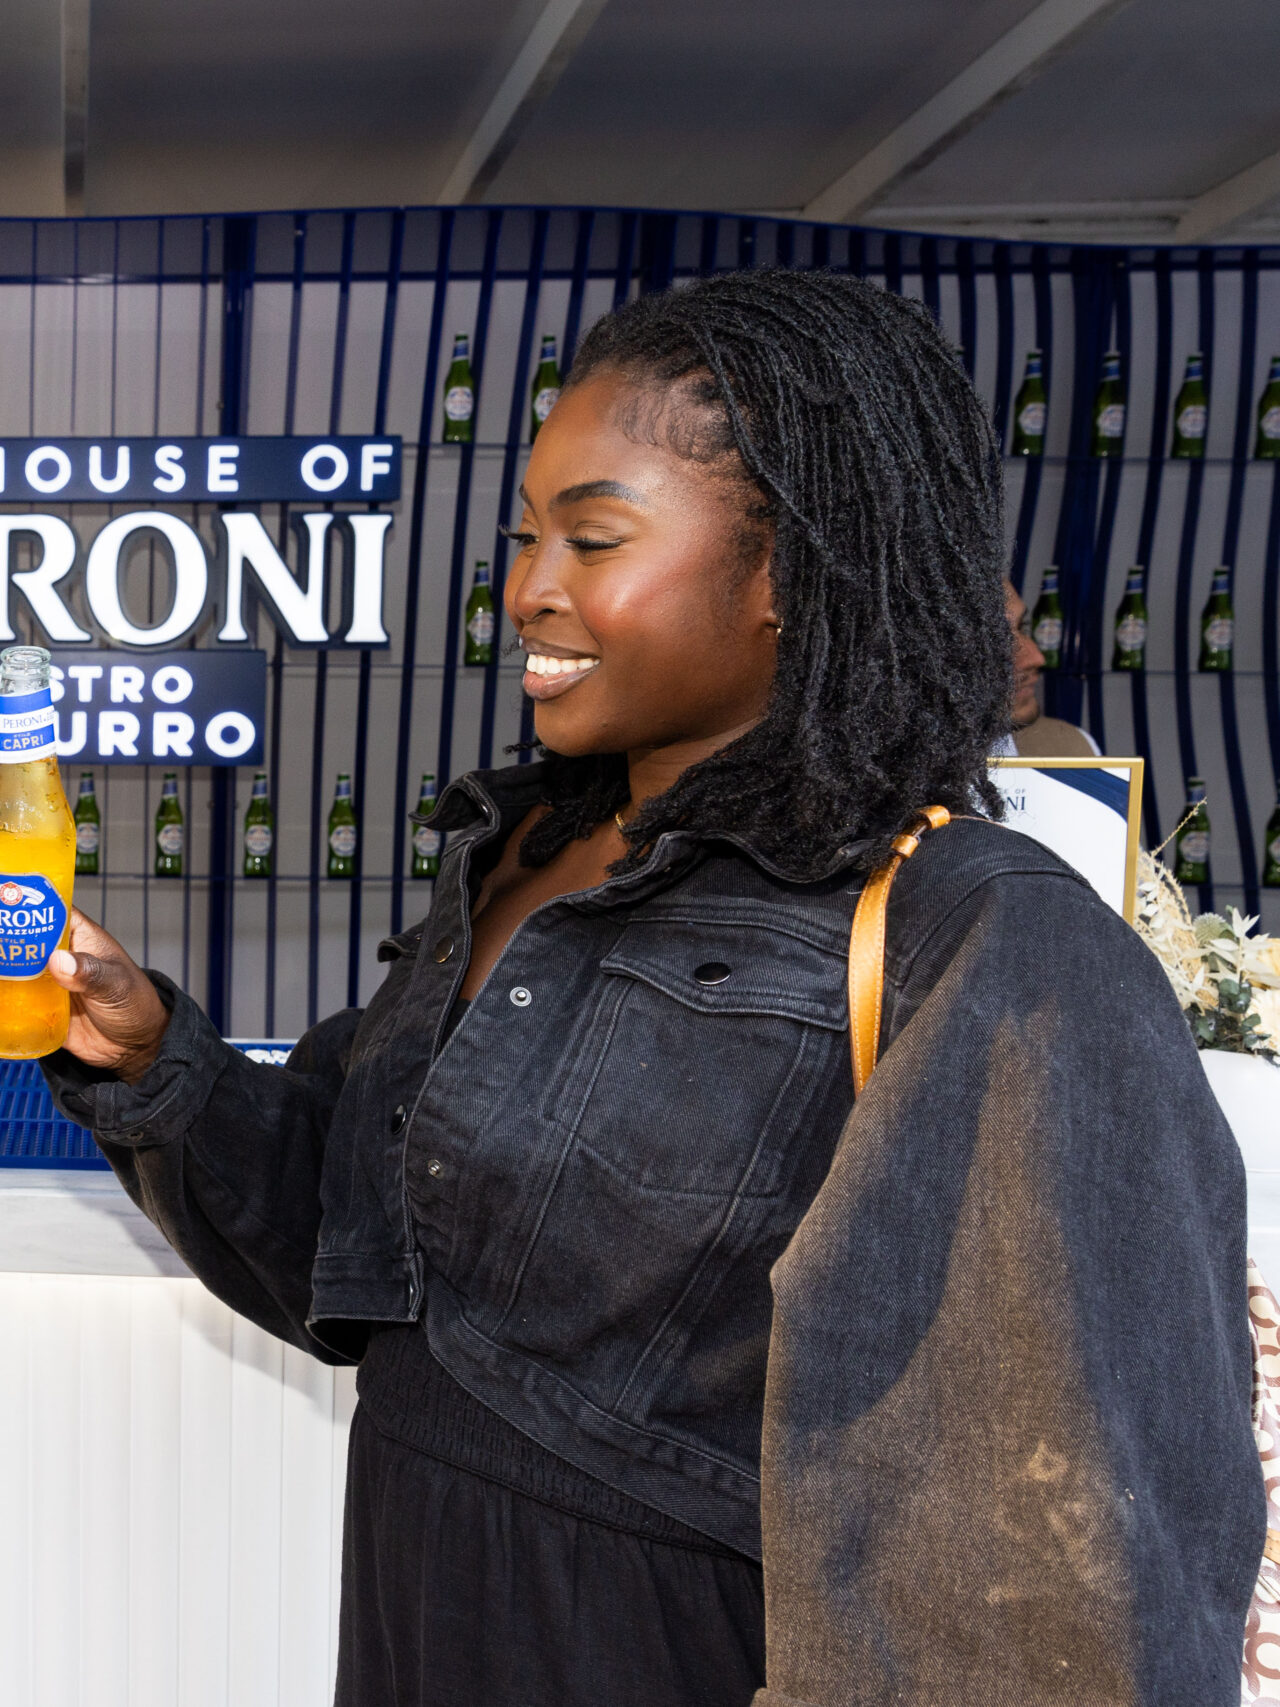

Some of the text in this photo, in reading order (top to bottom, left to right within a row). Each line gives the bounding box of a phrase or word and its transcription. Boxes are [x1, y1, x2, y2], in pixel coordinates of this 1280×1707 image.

[300, 443, 394, 493] OF
[3, 714, 43, 729] PERONI
[3, 734, 44, 750] CAPRI
[6, 924, 55, 936] AZZURRO
